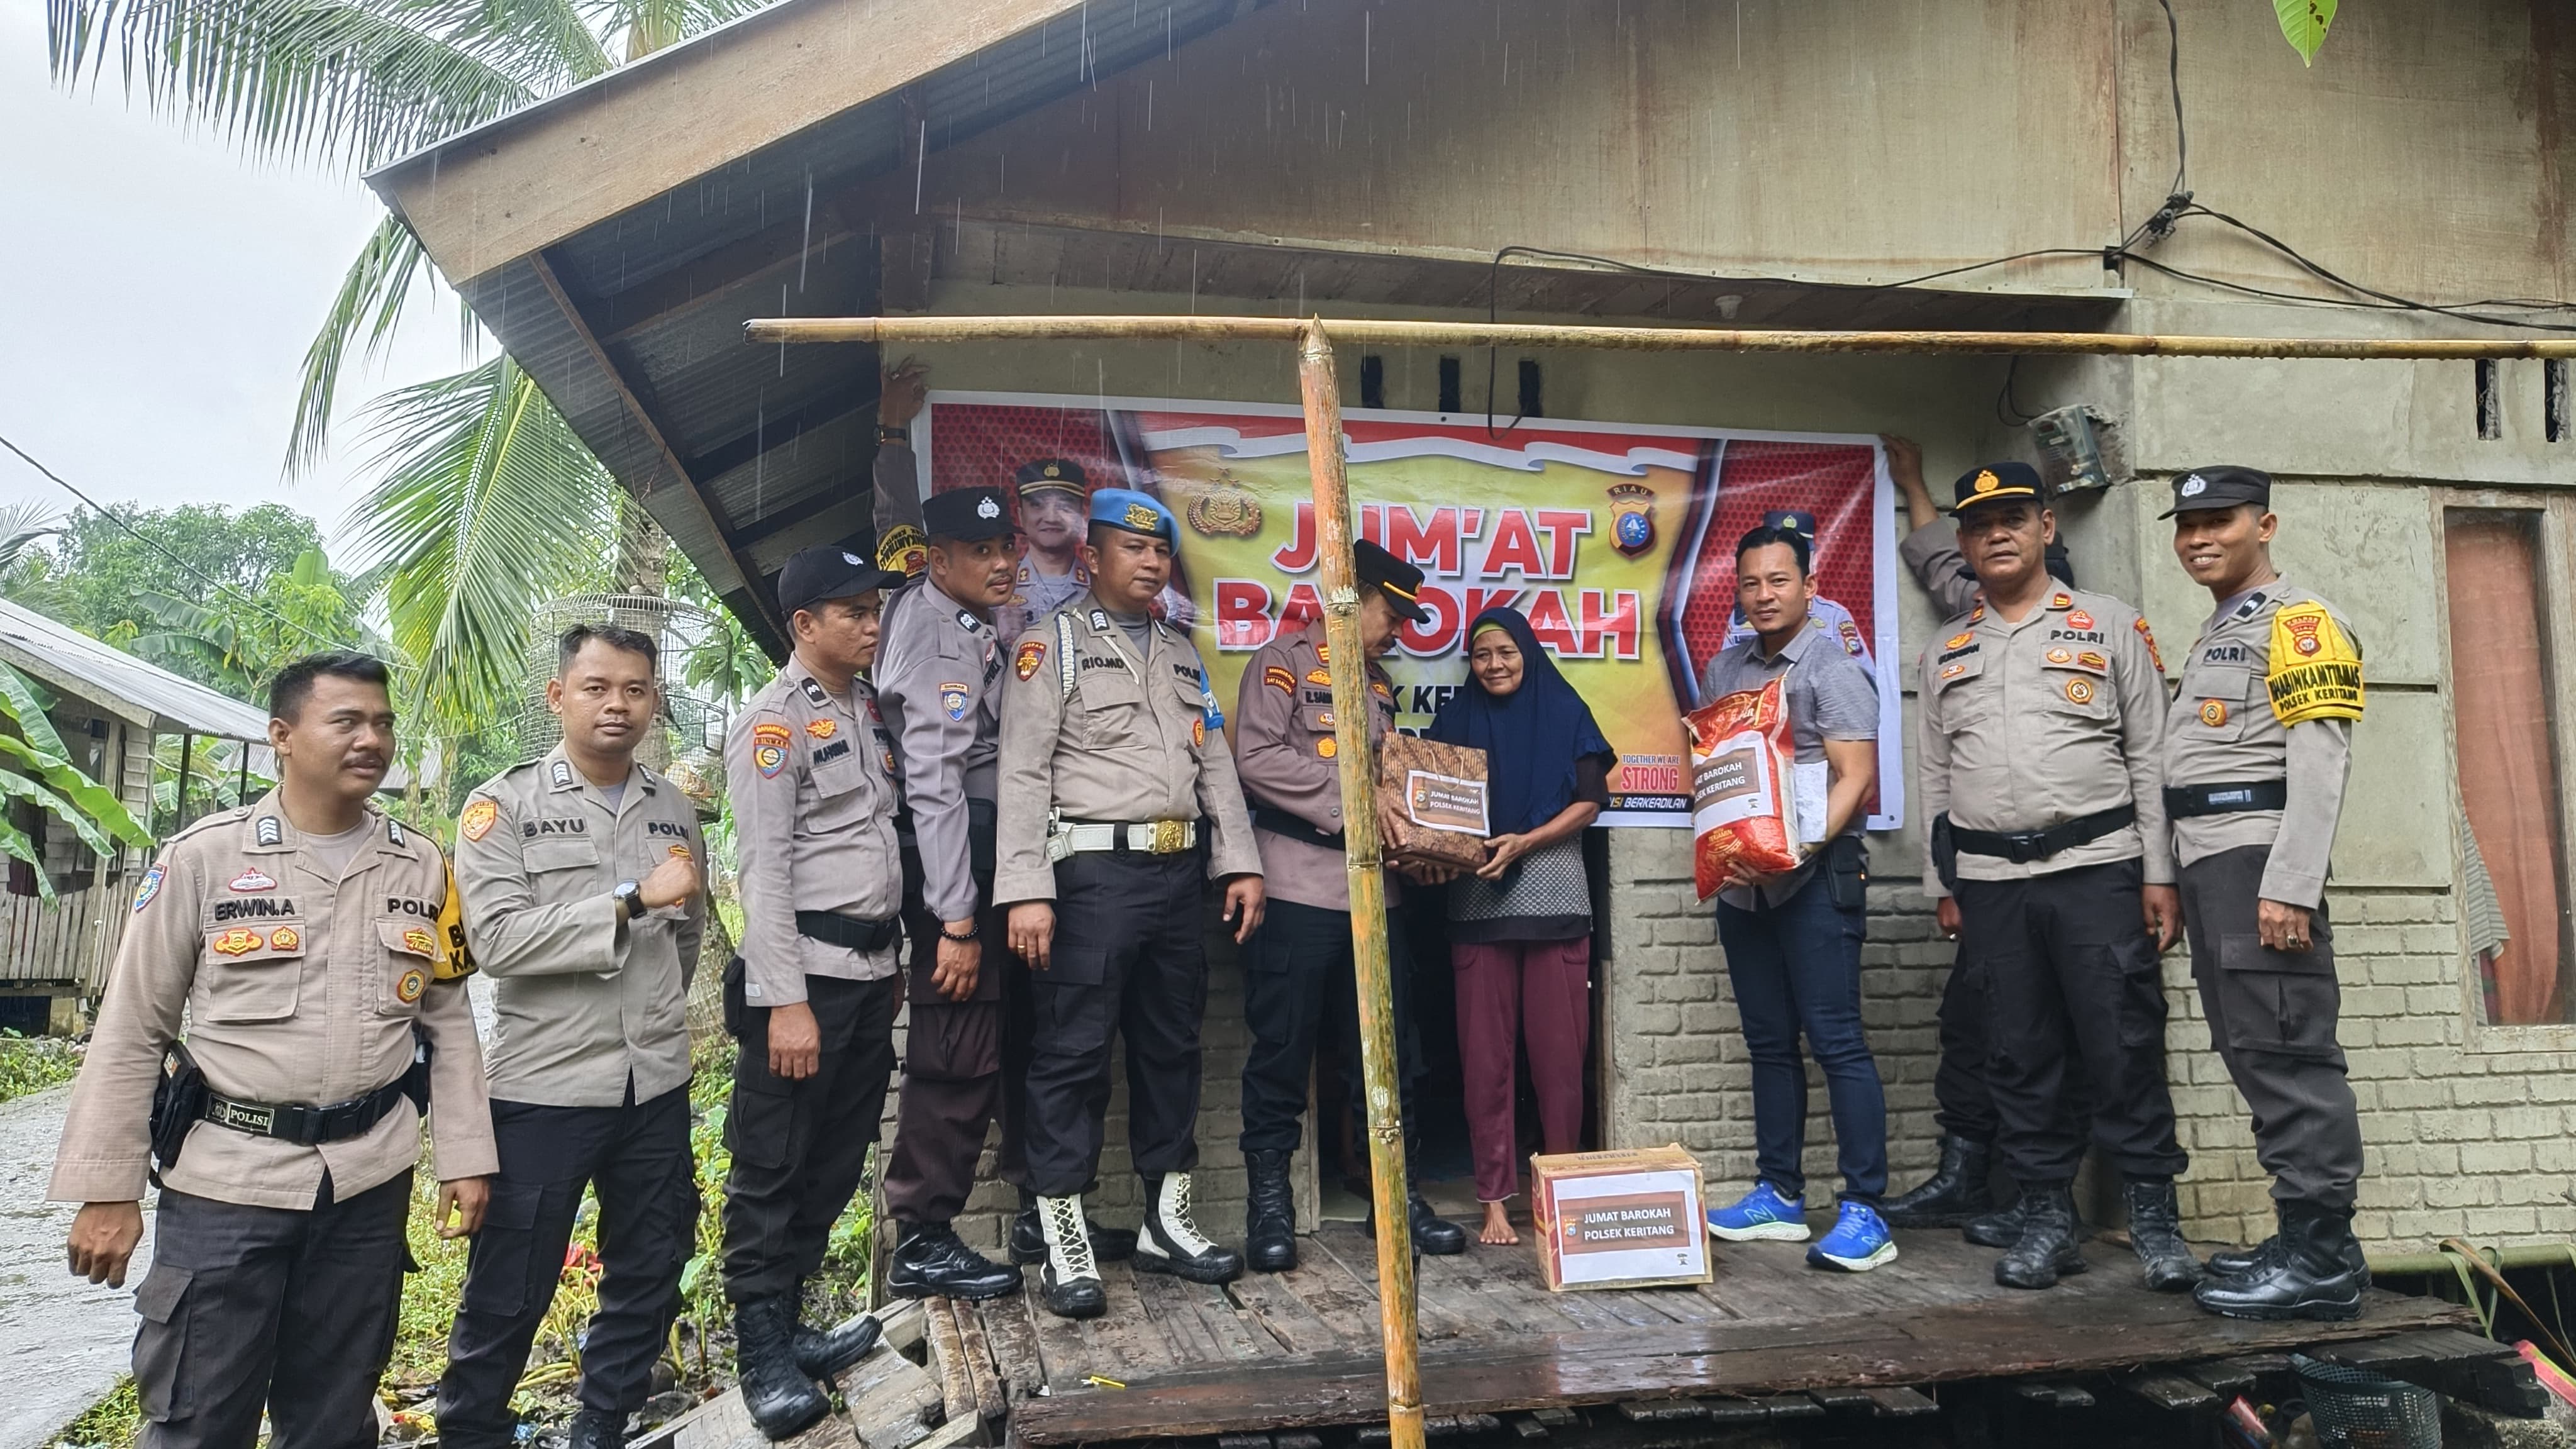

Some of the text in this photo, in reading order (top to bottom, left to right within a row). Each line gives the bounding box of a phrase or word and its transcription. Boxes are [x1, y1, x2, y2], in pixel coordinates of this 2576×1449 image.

[1613, 486, 1648, 495] RIAU
[1214, 579, 1640, 660] BAOKAH
[2050, 630, 2104, 645] POLRI
[2203, 647, 2246, 662] POLRI
[2279, 687, 2358, 714] POLSEK KERITANG
[1622, 754, 1680, 765] TOGETHER WE ARE
[1621, 765, 1679, 791] STRONG
[1703, 762, 1742, 780] BAROKAH
[1706, 776, 1746, 795] KERITANG
[1430, 791, 1479, 805] JUMAT BAROKAH
[1624, 796, 1687, 809] BERKEADILAN
[1430, 801, 1481, 815] POLSEK KERITANG
[523, 818, 585, 837] BAYU
[214, 898, 296, 921] ERWIN.A
[230, 1109, 269, 1126] POLISI
[1584, 1208, 1672, 1224] JUMAT BAROKAH
[1584, 1224, 1675, 1241] POLSEK KERITANG
